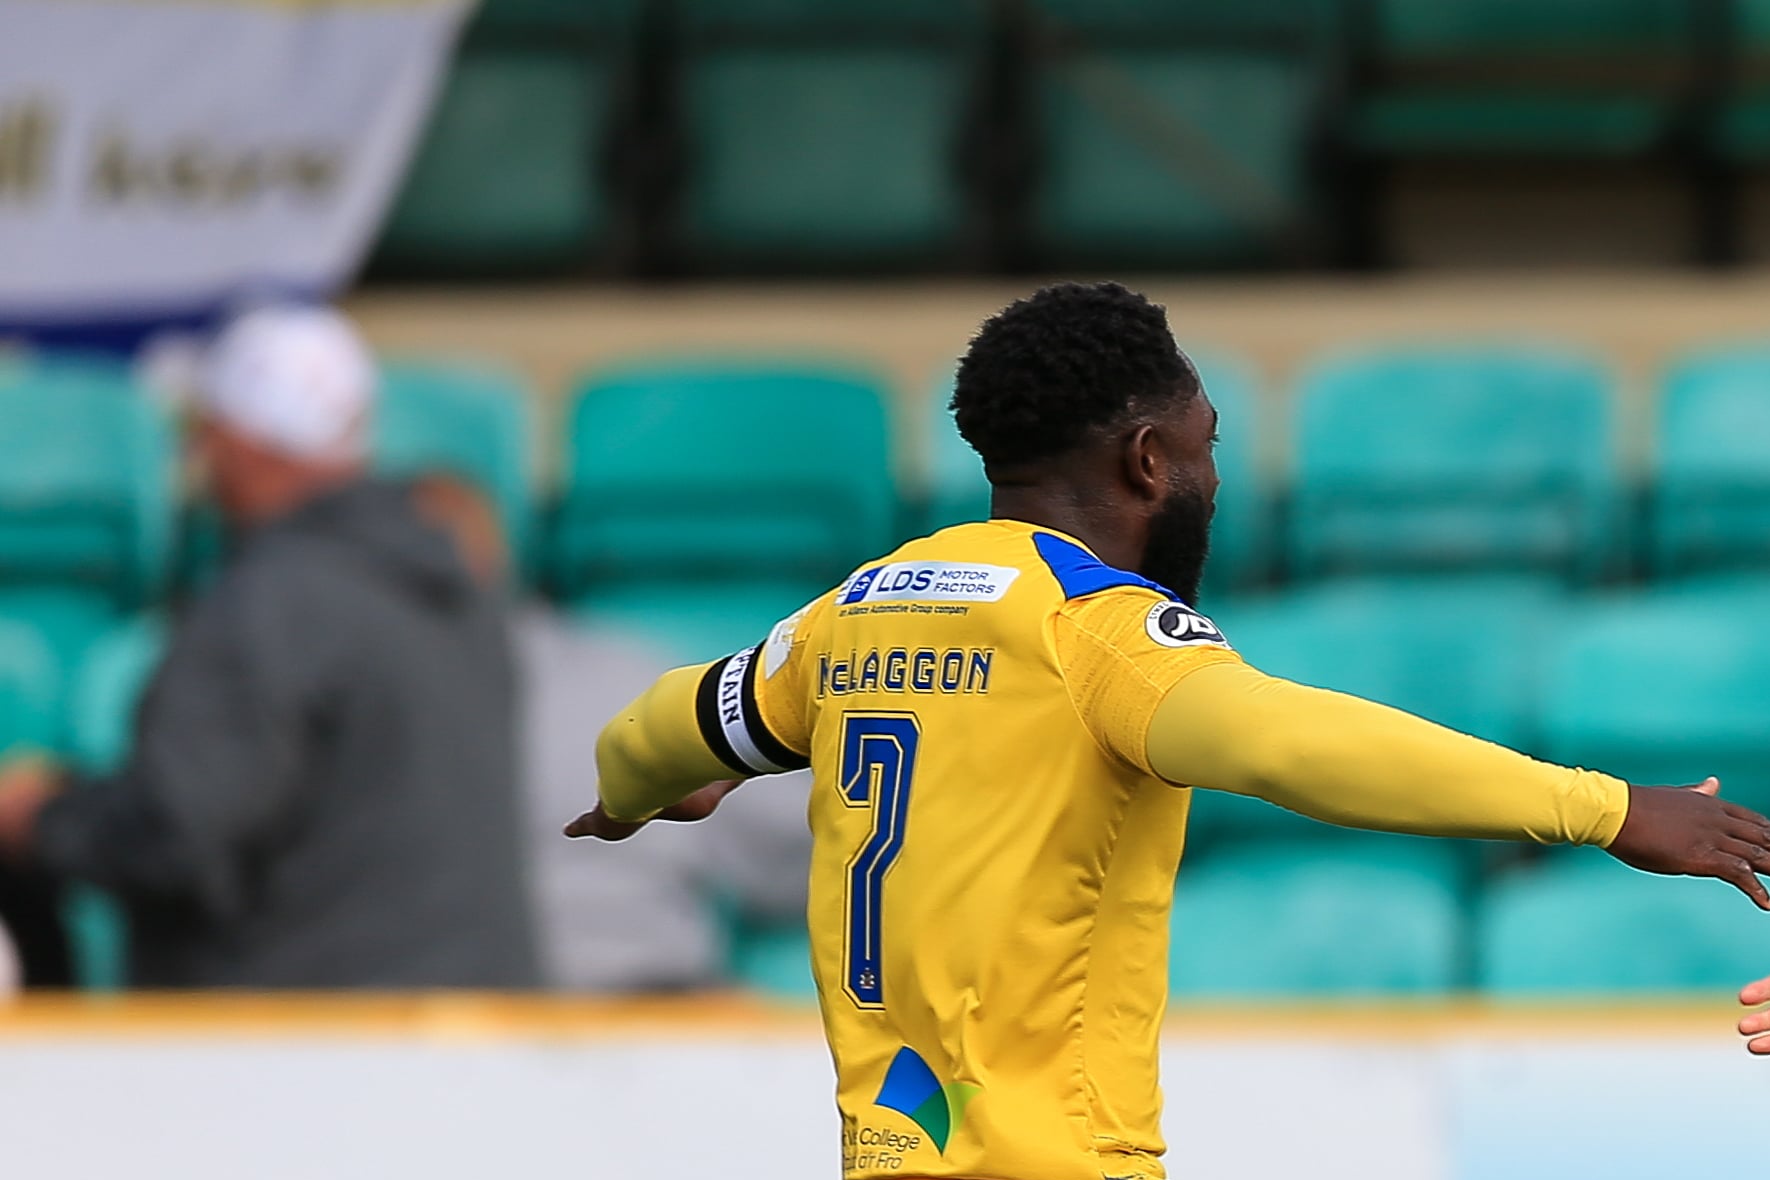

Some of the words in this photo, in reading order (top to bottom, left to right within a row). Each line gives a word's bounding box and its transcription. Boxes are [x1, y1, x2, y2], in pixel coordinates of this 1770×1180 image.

[877, 569, 935, 592] LDS
[939, 570, 989, 581] MOTOR
[933, 582, 997, 594] FACTORS
[870, 604, 909, 614] Automotive
[910, 603, 933, 614] Group
[934, 605, 970, 617] company
[1170, 612, 1218, 637] JD
[836, 709, 921, 1010] 7
[860, 1127, 920, 1153] College
[876, 1152, 903, 1169] Fro
